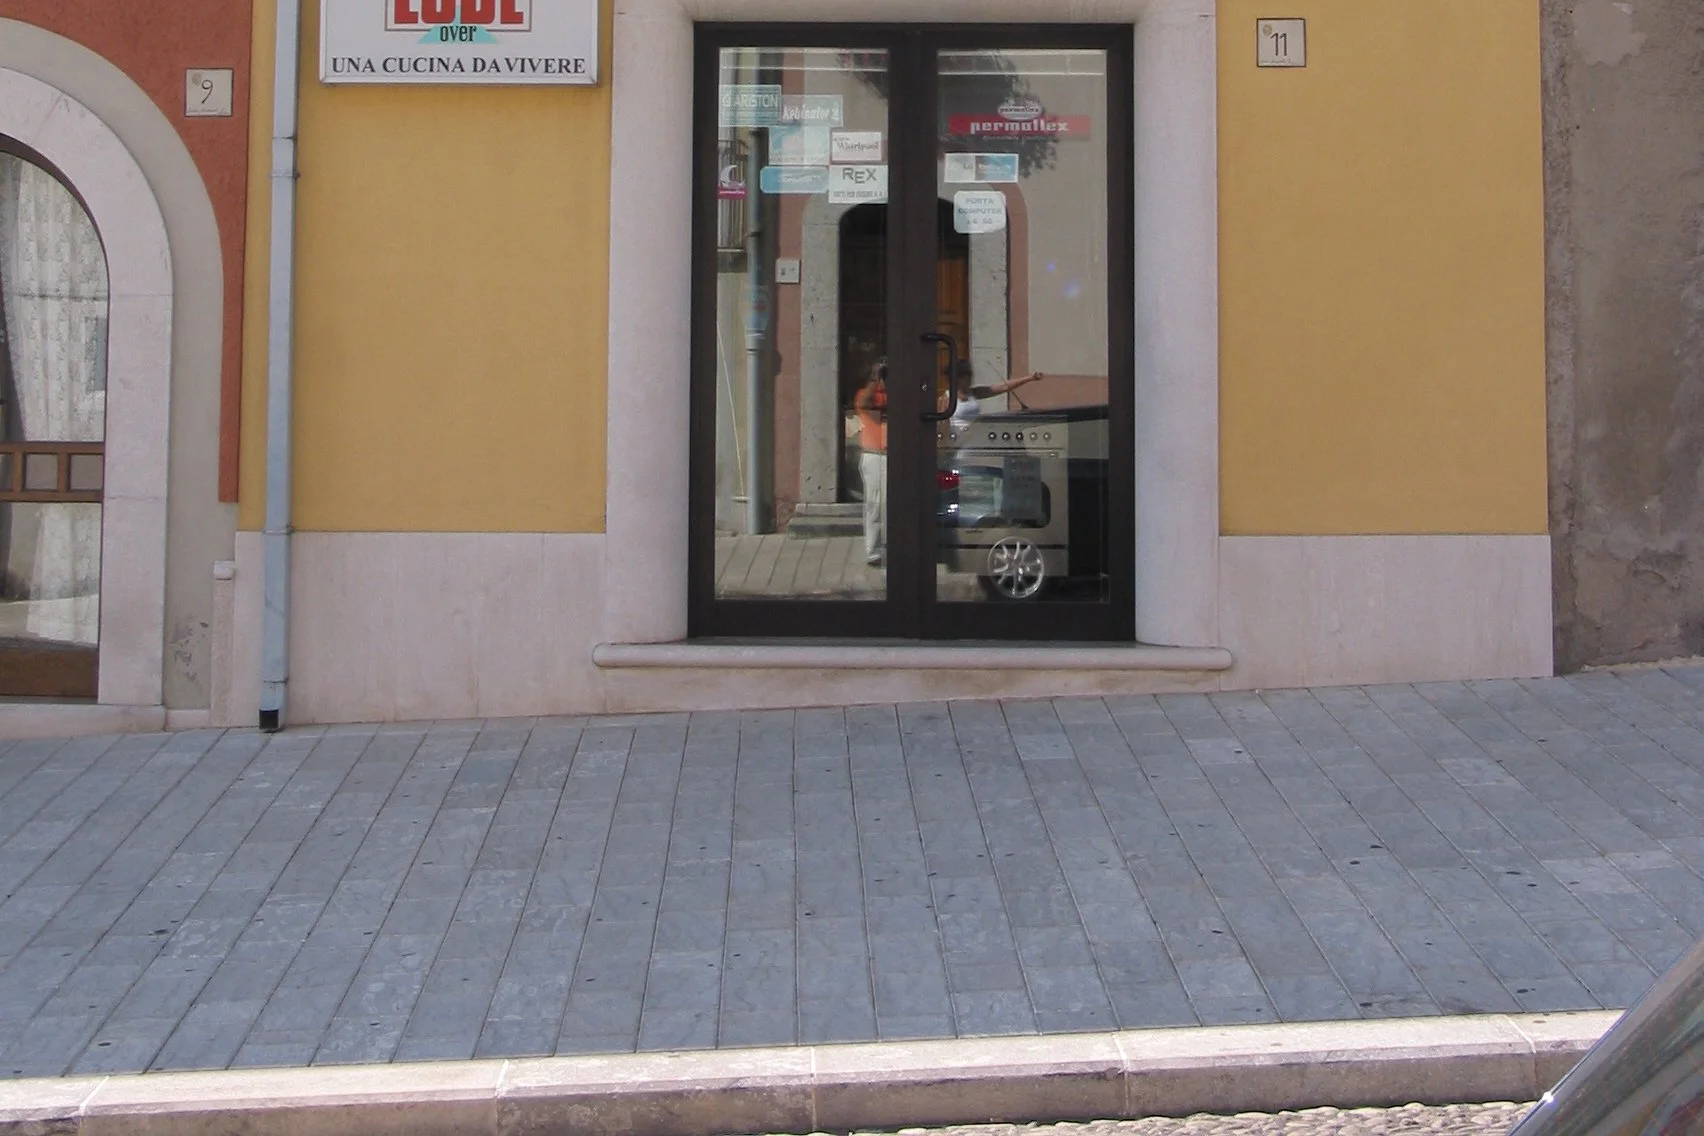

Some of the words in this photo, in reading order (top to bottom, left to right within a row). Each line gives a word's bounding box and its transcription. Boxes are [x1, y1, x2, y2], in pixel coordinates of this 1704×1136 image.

[440, 24, 477, 43] over
[1270, 32, 1288, 57] 11
[332, 57, 376, 74] UNA
[382, 57, 465, 74] CUCINA
[200, 79, 213, 105] 9
[733, 94, 778, 108] ARISTON
[969, 118, 1069, 135] permaflex
[842, 167, 878, 185] REX
